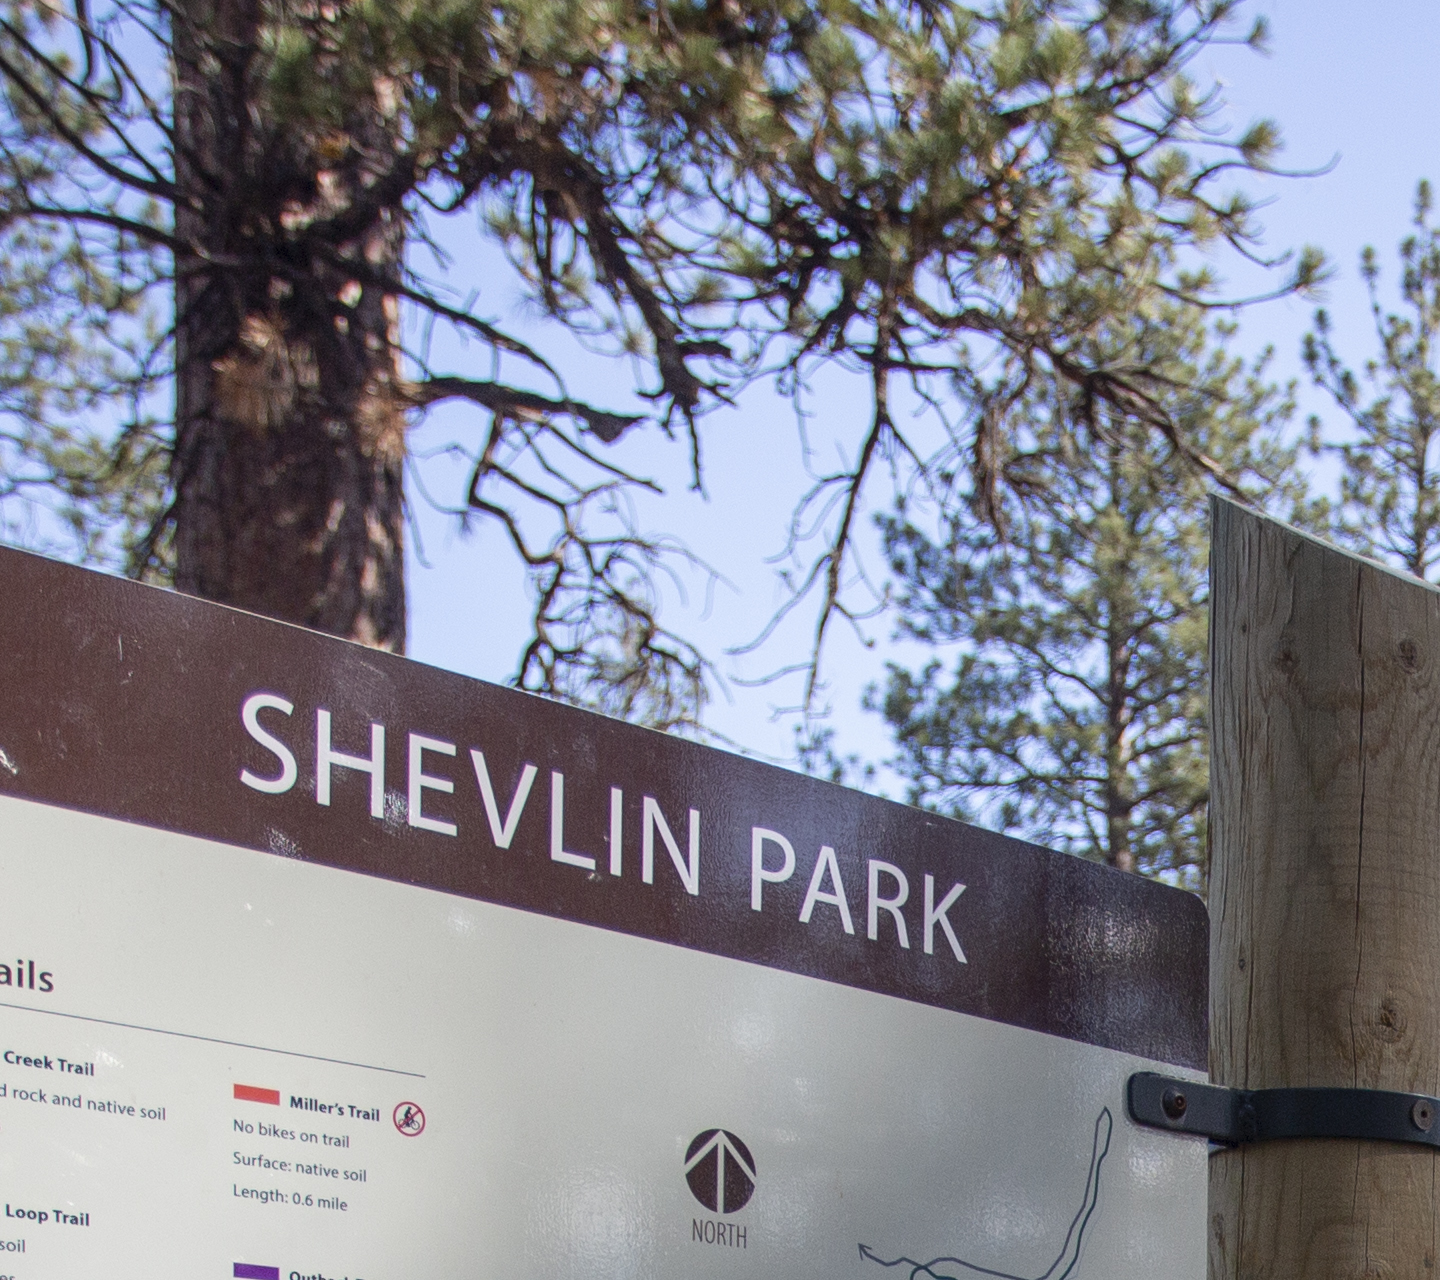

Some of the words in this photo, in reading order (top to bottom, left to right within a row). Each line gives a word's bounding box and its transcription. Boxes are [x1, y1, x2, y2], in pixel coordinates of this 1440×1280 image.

[238, 691, 703, 898] SHEVLIN
[751, 826, 966, 963] PARK
[4, 1051, 52, 1069] Creek
[58, 1059, 93, 1075] Trail
[13, 1089, 46, 1103] rock
[52, 1090, 81, 1108] and
[88, 1100, 135, 1116] native
[141, 1108, 165, 1120] soil
[291, 1096, 344, 1115] Miller's
[348, 1105, 379, 1121] Trail
[234, 1120, 253, 1133] No
[259, 1123, 295, 1140] bikes
[300, 1133, 318, 1143] on
[323, 1134, 349, 1147] trail
[234, 1152, 291, 1171] Surface:
[296, 1164, 338, 1178] native
[344, 1170, 366, 1181] soil
[234, 1184, 289, 1203] Length:
[293, 1193, 313, 1206] 0.6
[318, 1198, 347, 1211] mile
[6, 1204, 48, 1224] Loop
[53, 1210, 89, 1226] Trail
[0, 1240, 25, 1252] soil
[693, 1219, 747, 1248] NORTH
